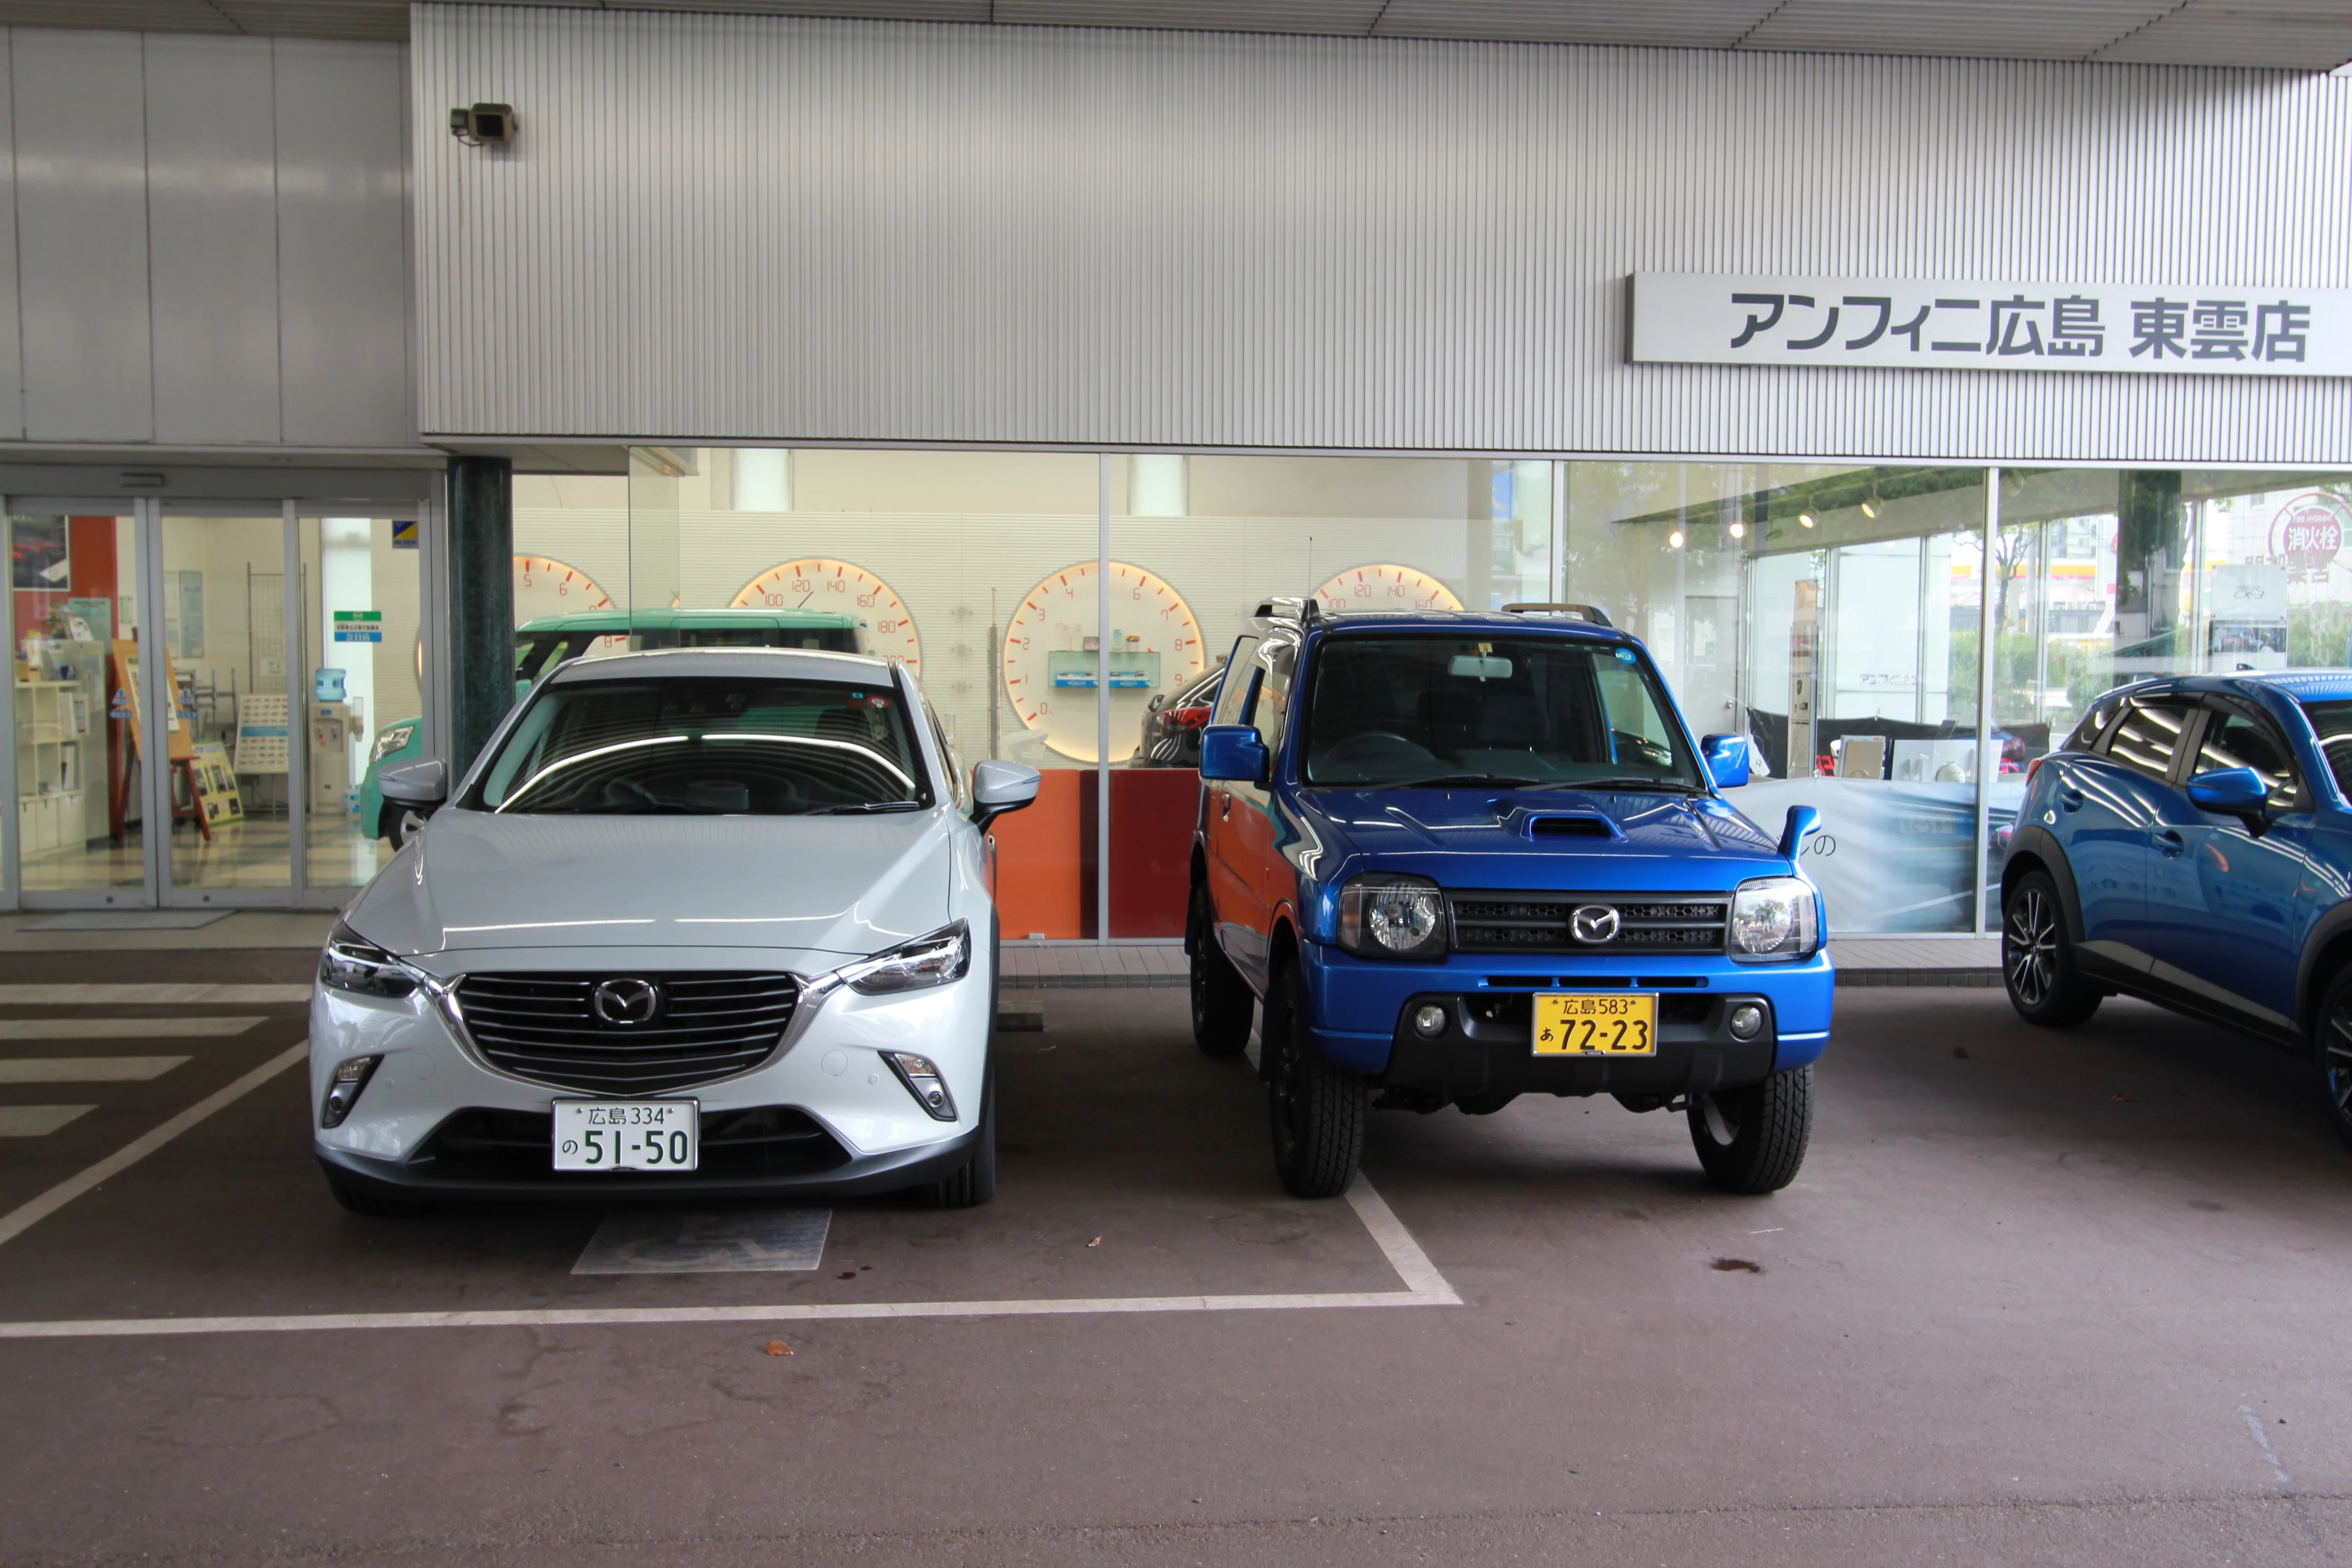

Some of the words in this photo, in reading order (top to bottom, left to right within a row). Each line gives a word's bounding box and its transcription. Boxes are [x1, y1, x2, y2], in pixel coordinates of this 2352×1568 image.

[1731, 293, 2105, 357] アンフィニ広島
[2128, 296, 2311, 362] 東雲店
[2288, 525, 2338, 551] 消火栓
[524, 574, 532, 588] 5
[792, 579, 810, 593] 120
[827, 580, 845, 593] 140
[559, 583, 567, 596] 6
[1065, 588, 1073, 598] 4
[1133, 588, 1141, 600] 6
[1354, 584, 1372, 597] 120
[1387, 585, 1405, 598] 140
[765, 593, 783, 607] 100
[857, 594, 875, 608] 160
[1039, 608, 1045, 621] 3
[1161, 609, 1169, 621] 7
[878, 620, 896, 633] 180
[1022, 637, 1030, 650] 2
[1175, 638, 1182, 651] 8
[1540, 1027, 1554, 1042] あ
[1560, 1019, 1648, 1050] 72-23
[562, 1139, 579, 1155] の
[585, 1130, 688, 1164] 51-50
